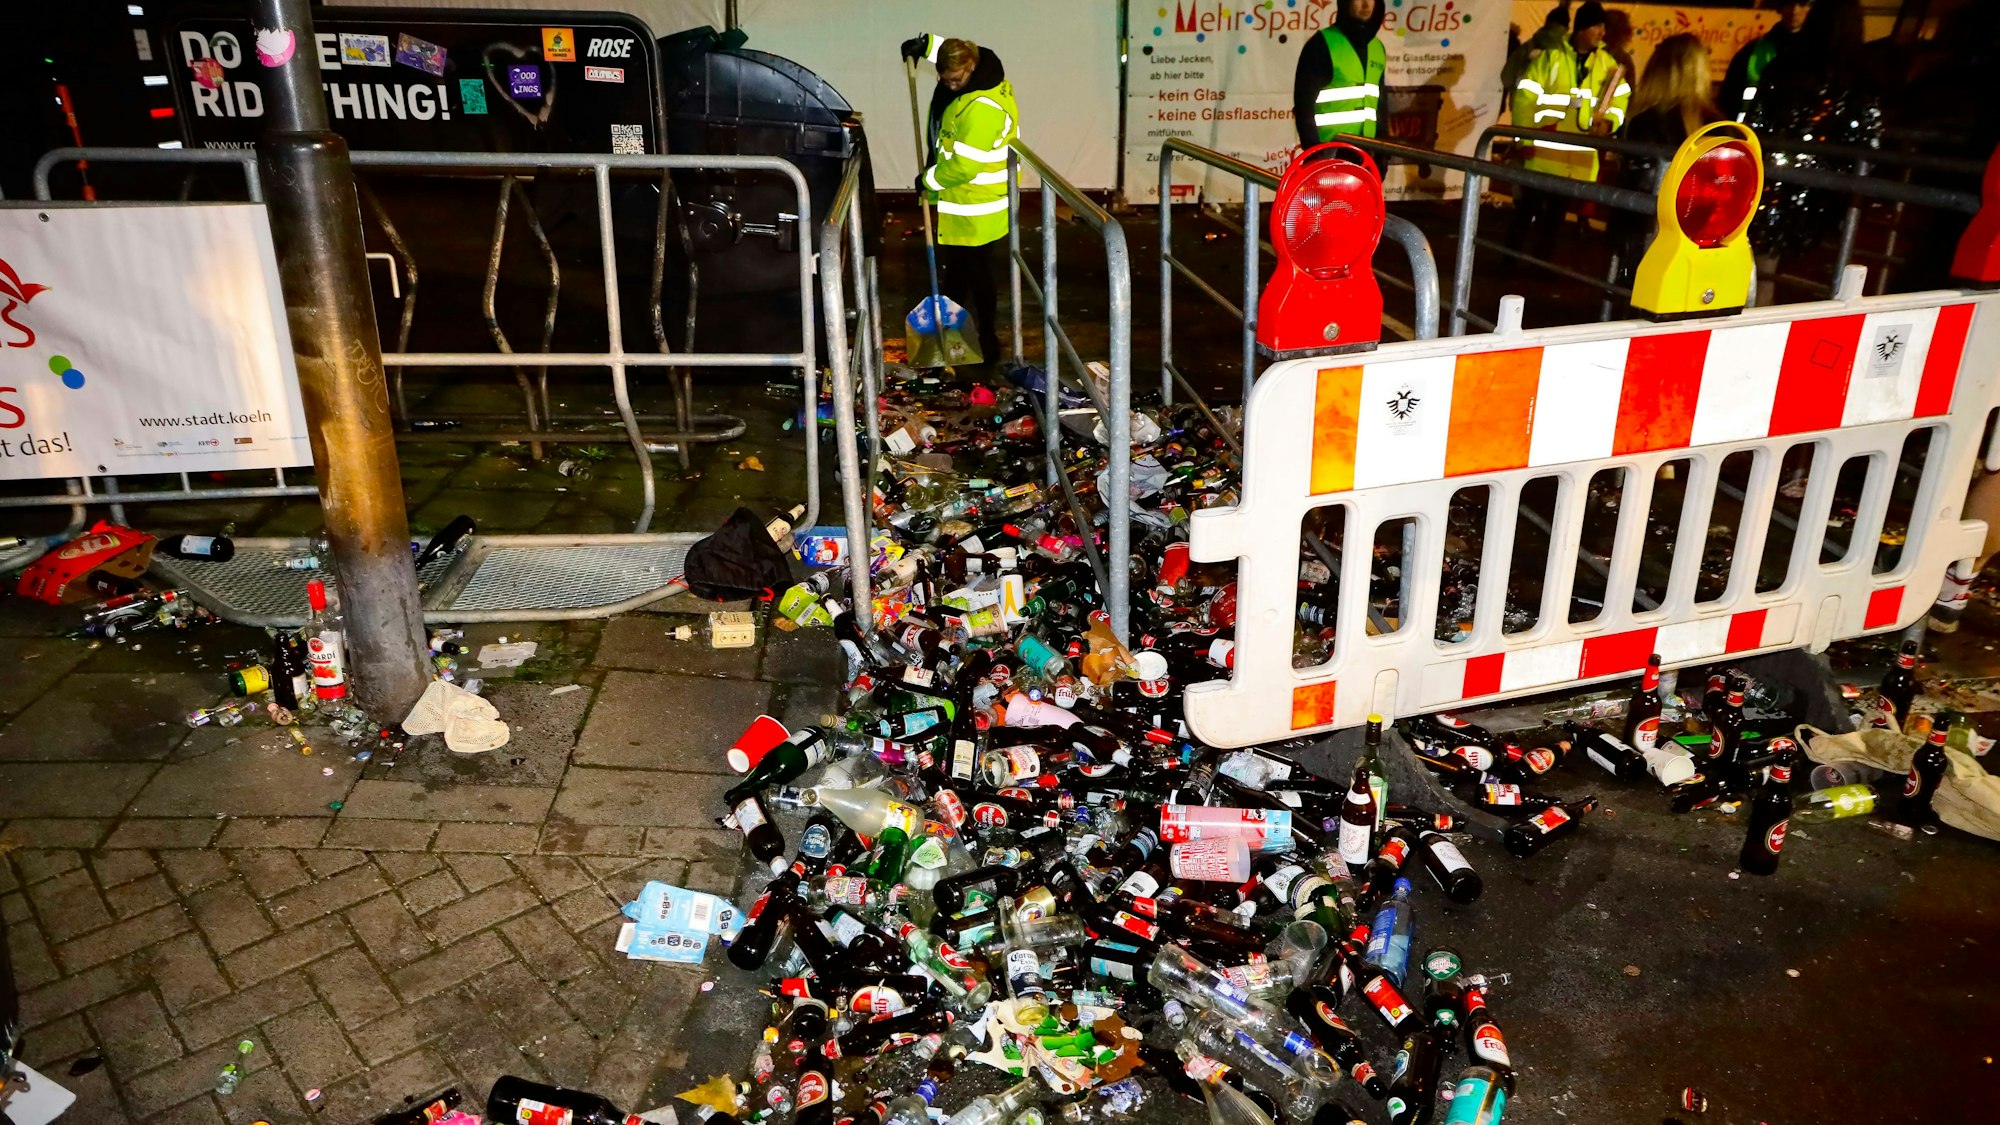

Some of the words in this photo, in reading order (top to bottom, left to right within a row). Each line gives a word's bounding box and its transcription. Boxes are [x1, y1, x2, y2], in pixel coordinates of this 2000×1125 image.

[1406, 4, 1461, 33] Glas
[586, 38, 634, 58] ROSE
[1150, 55, 1176, 64] Liebe
[1179, 54, 1214, 65] Jecken,
[1150, 71, 1162, 80] ab
[1164, 71, 1181, 80] hier
[1184, 71, 1205, 80] bitte
[1158, 88, 1189, 102] kein
[1193, 87, 1226, 101] Glas
[1158, 108, 1197, 121] keine
[1201, 107, 1295, 121] Glasflaschen
[1147, 129, 1195, 138] mitführen.
[138, 410, 273, 428] www.stadt.koeln
[20, 432, 73, 457] das!
